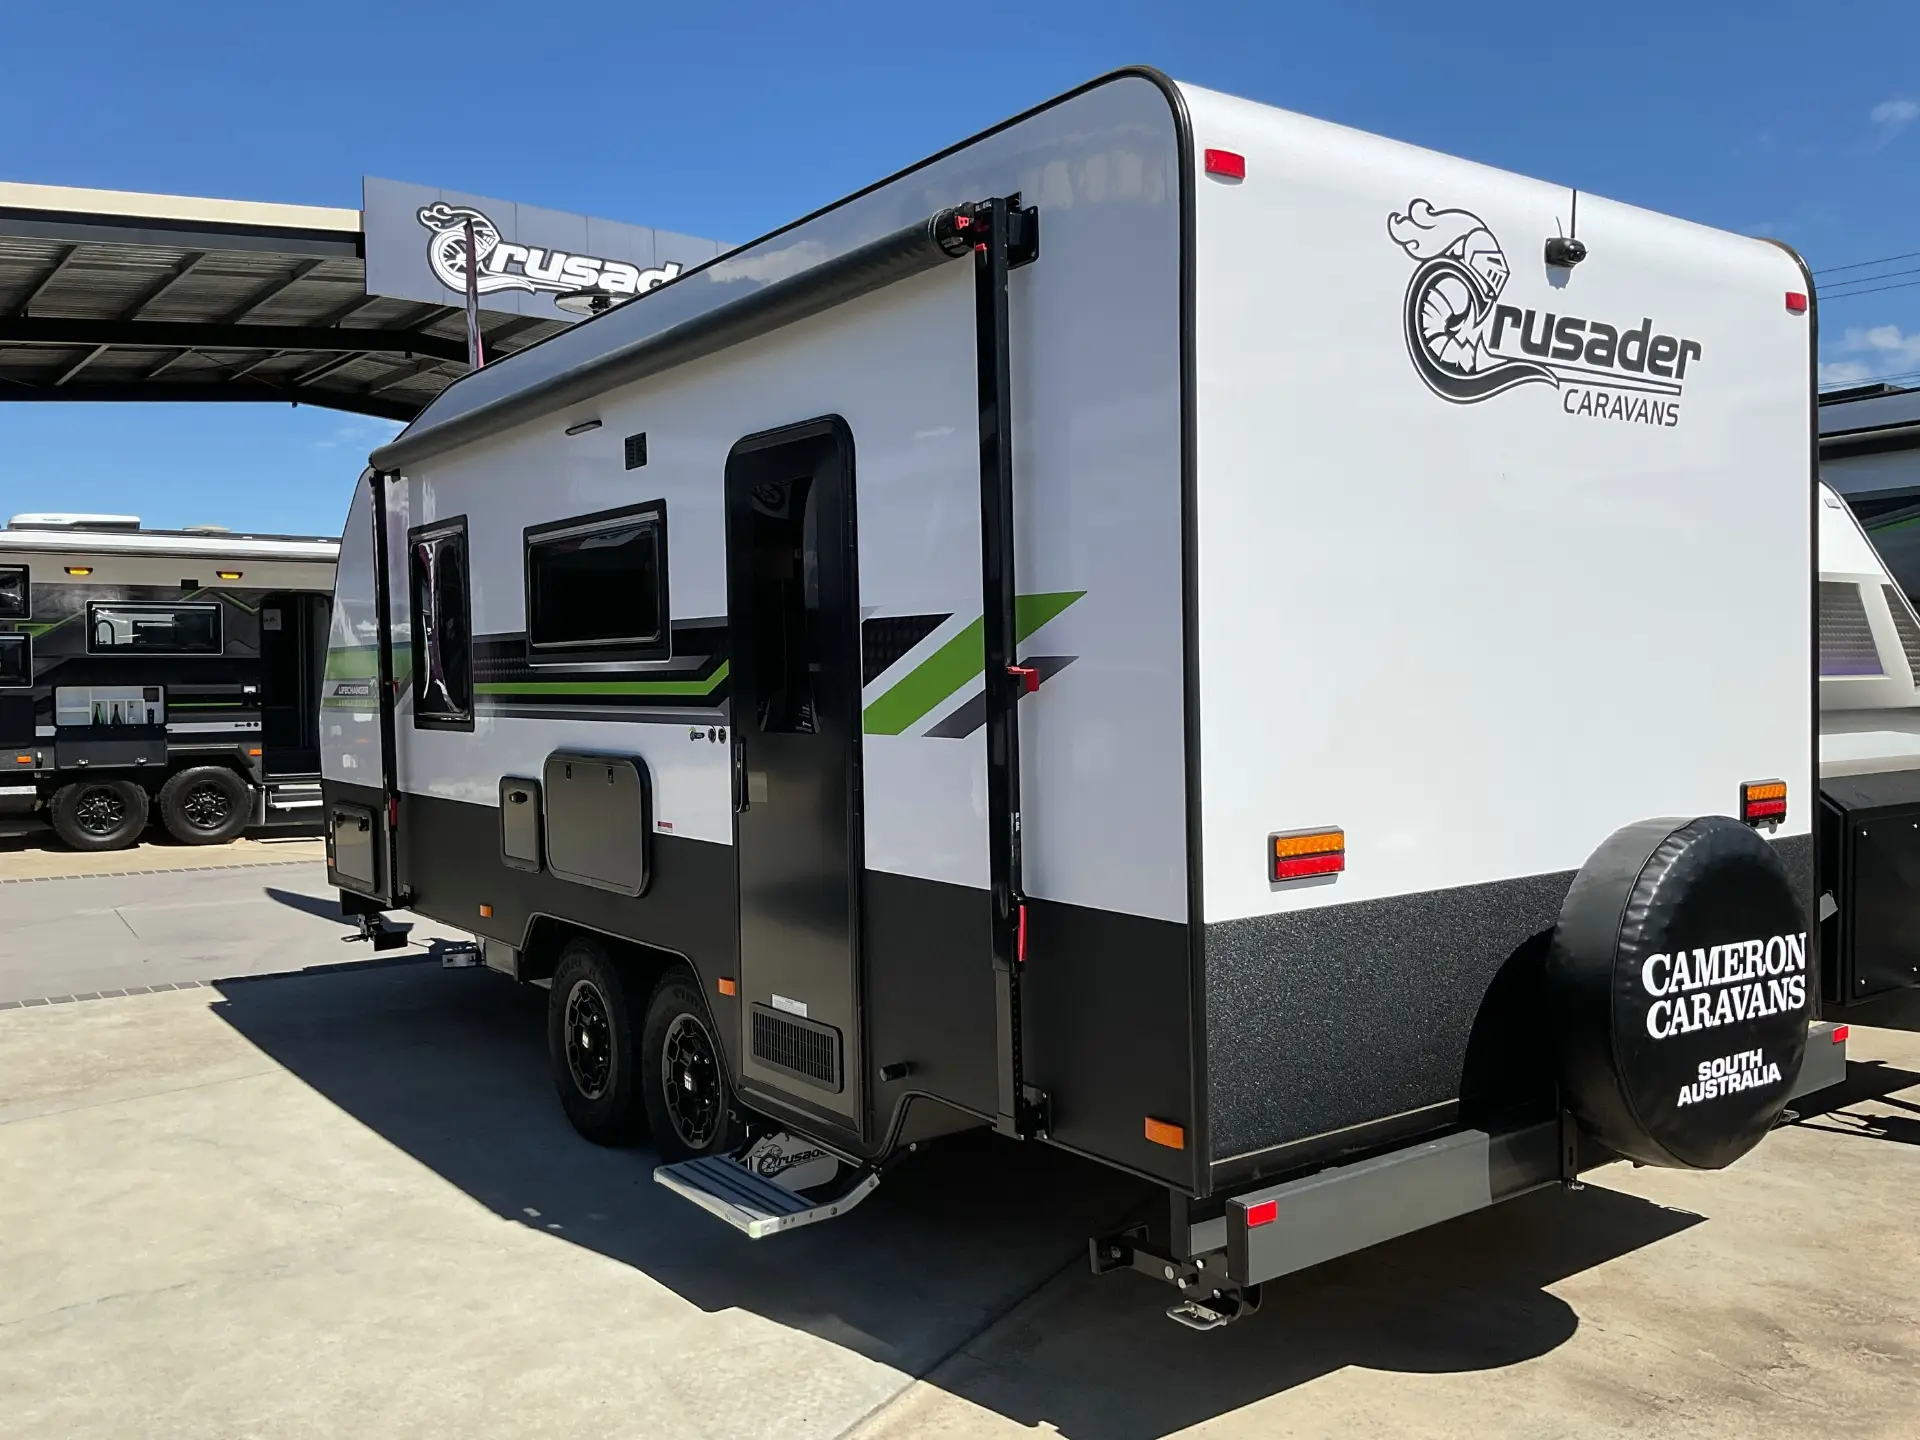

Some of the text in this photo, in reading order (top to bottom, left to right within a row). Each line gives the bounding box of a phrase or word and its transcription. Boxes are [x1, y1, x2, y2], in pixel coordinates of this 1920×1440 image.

[427, 228, 682, 295] Crusad
[1563, 388, 1680, 427] CARAVANS
[1641, 931, 1807, 997] CAMERON
[1646, 974, 1806, 1039] CARAVANS
[1677, 1062, 1782, 1107] AUSTRALIA
[1698, 1048, 1762, 1081] SOUTH
